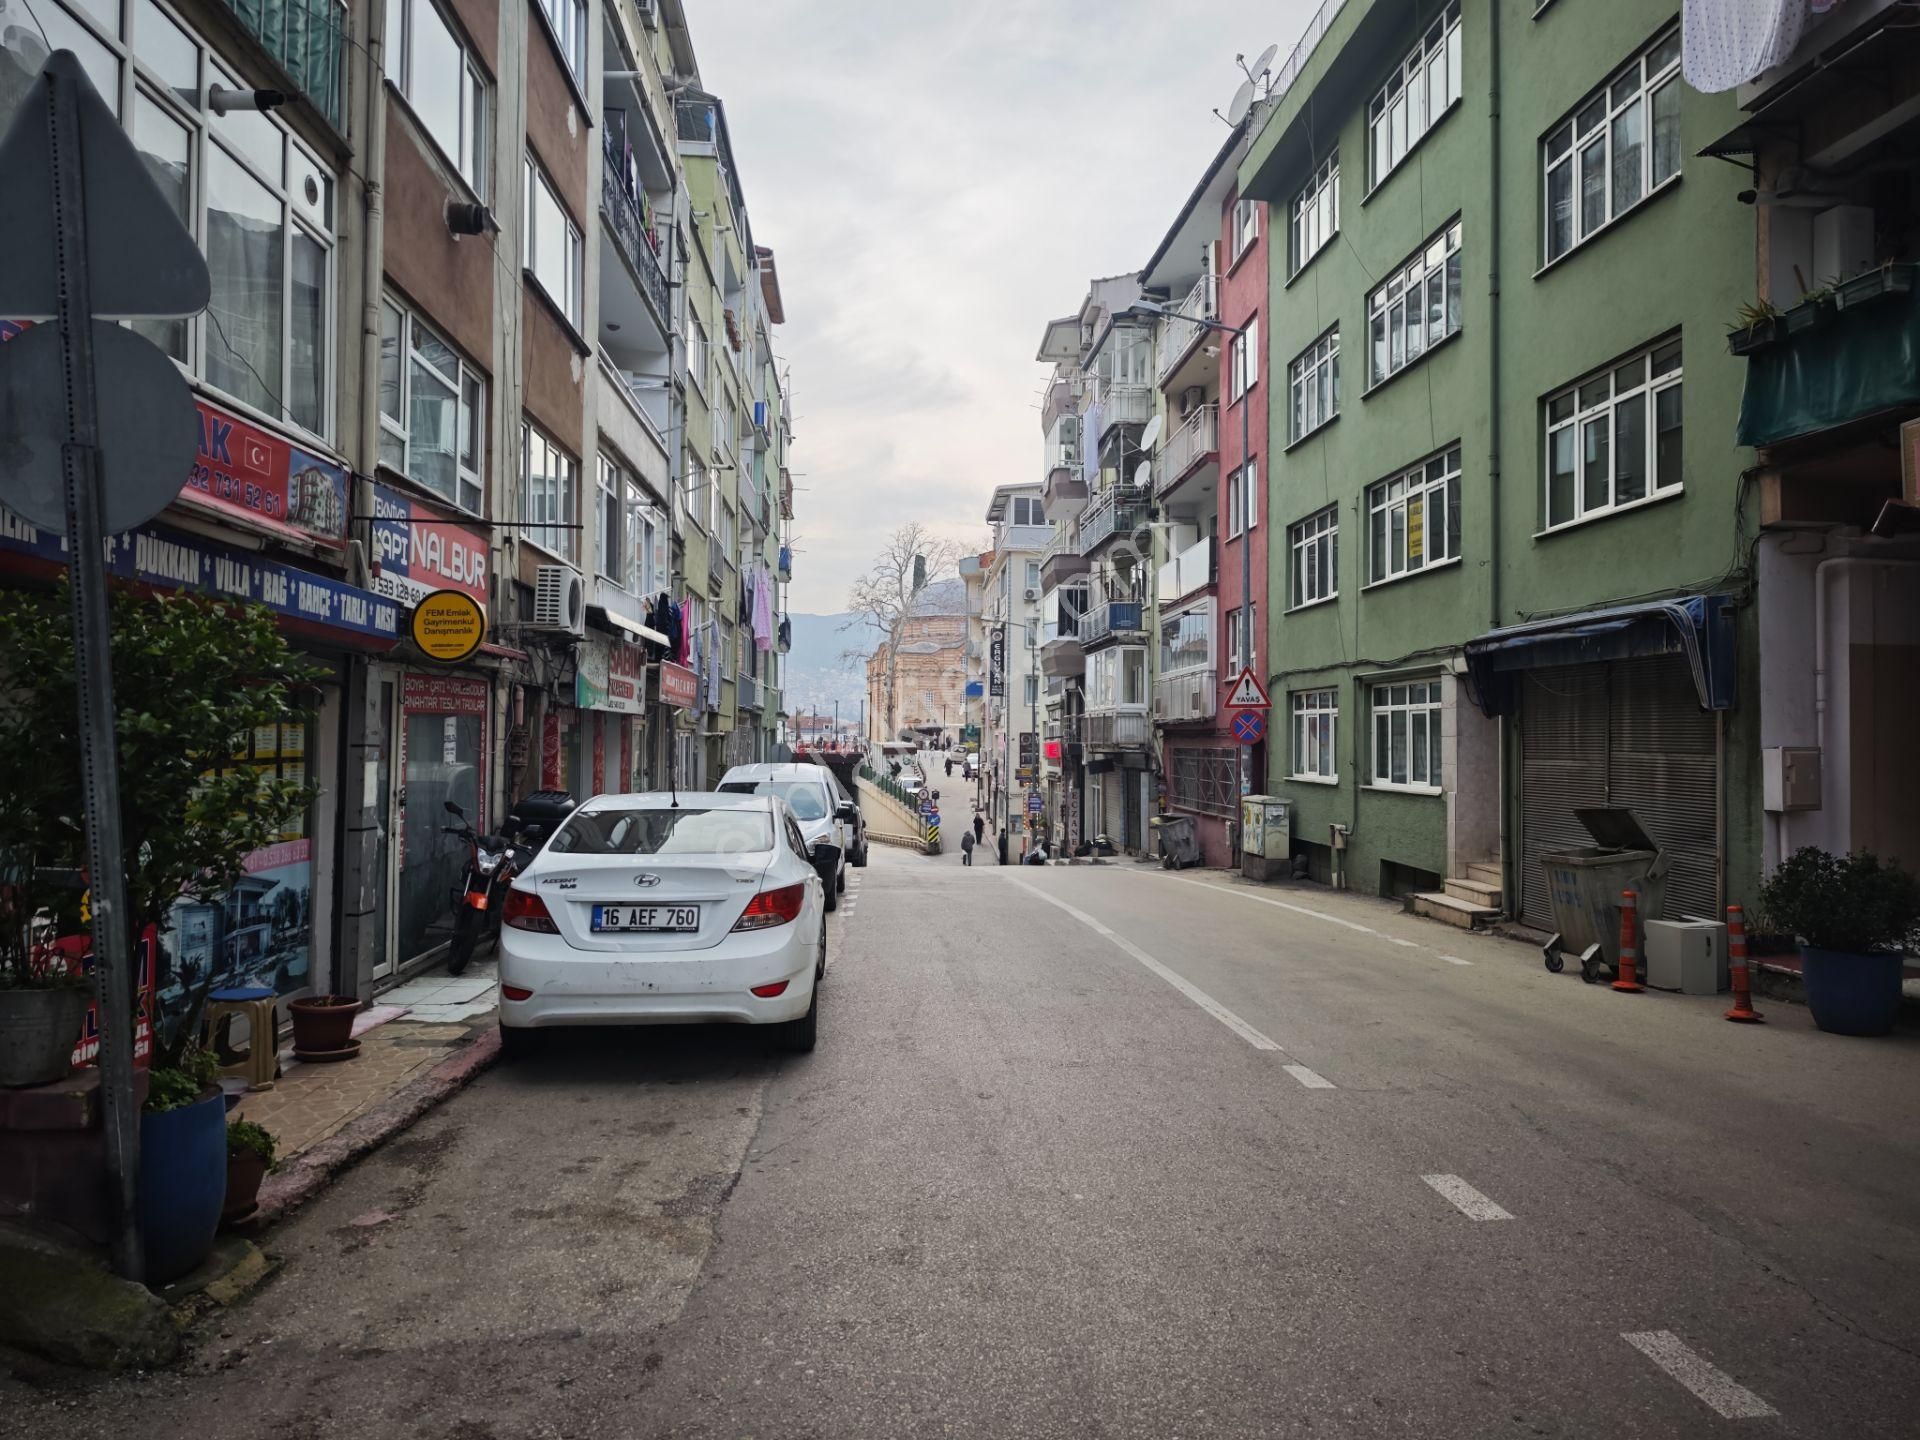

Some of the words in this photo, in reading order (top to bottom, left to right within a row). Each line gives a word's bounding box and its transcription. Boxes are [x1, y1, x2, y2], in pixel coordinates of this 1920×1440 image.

[214, 471, 241, 504] 731
[245, 482, 263, 511] 52
[264, 490, 281, 517] 61
[411, 523, 486, 591] NALBUR
[136, 530, 200, 585] DÜKKAN
[215, 553, 250, 597] VİLLA
[263, 569, 288, 607] BAĞ
[298, 581, 331, 622] BAHÇE
[340, 593, 367, 626] TARLA
[374, 603, 397, 633] ARSA
[378, 576, 394, 596] 533
[426, 608, 445, 617] FEM
[446, 608, 471, 617] Emlak
[423, 618, 474, 627] Gayrimenkul
[424, 627, 473, 636] Danışmanlık
[993, 643, 1001, 684] ERGUVAN
[405, 678, 424, 692] BOYA
[609, 680, 631, 697] MARKET
[404, 695, 438, 709] ANAHTAR
[604, 908, 620, 926] 16
[629, 908, 658, 926] AEF
[667, 909, 695, 926] 760
